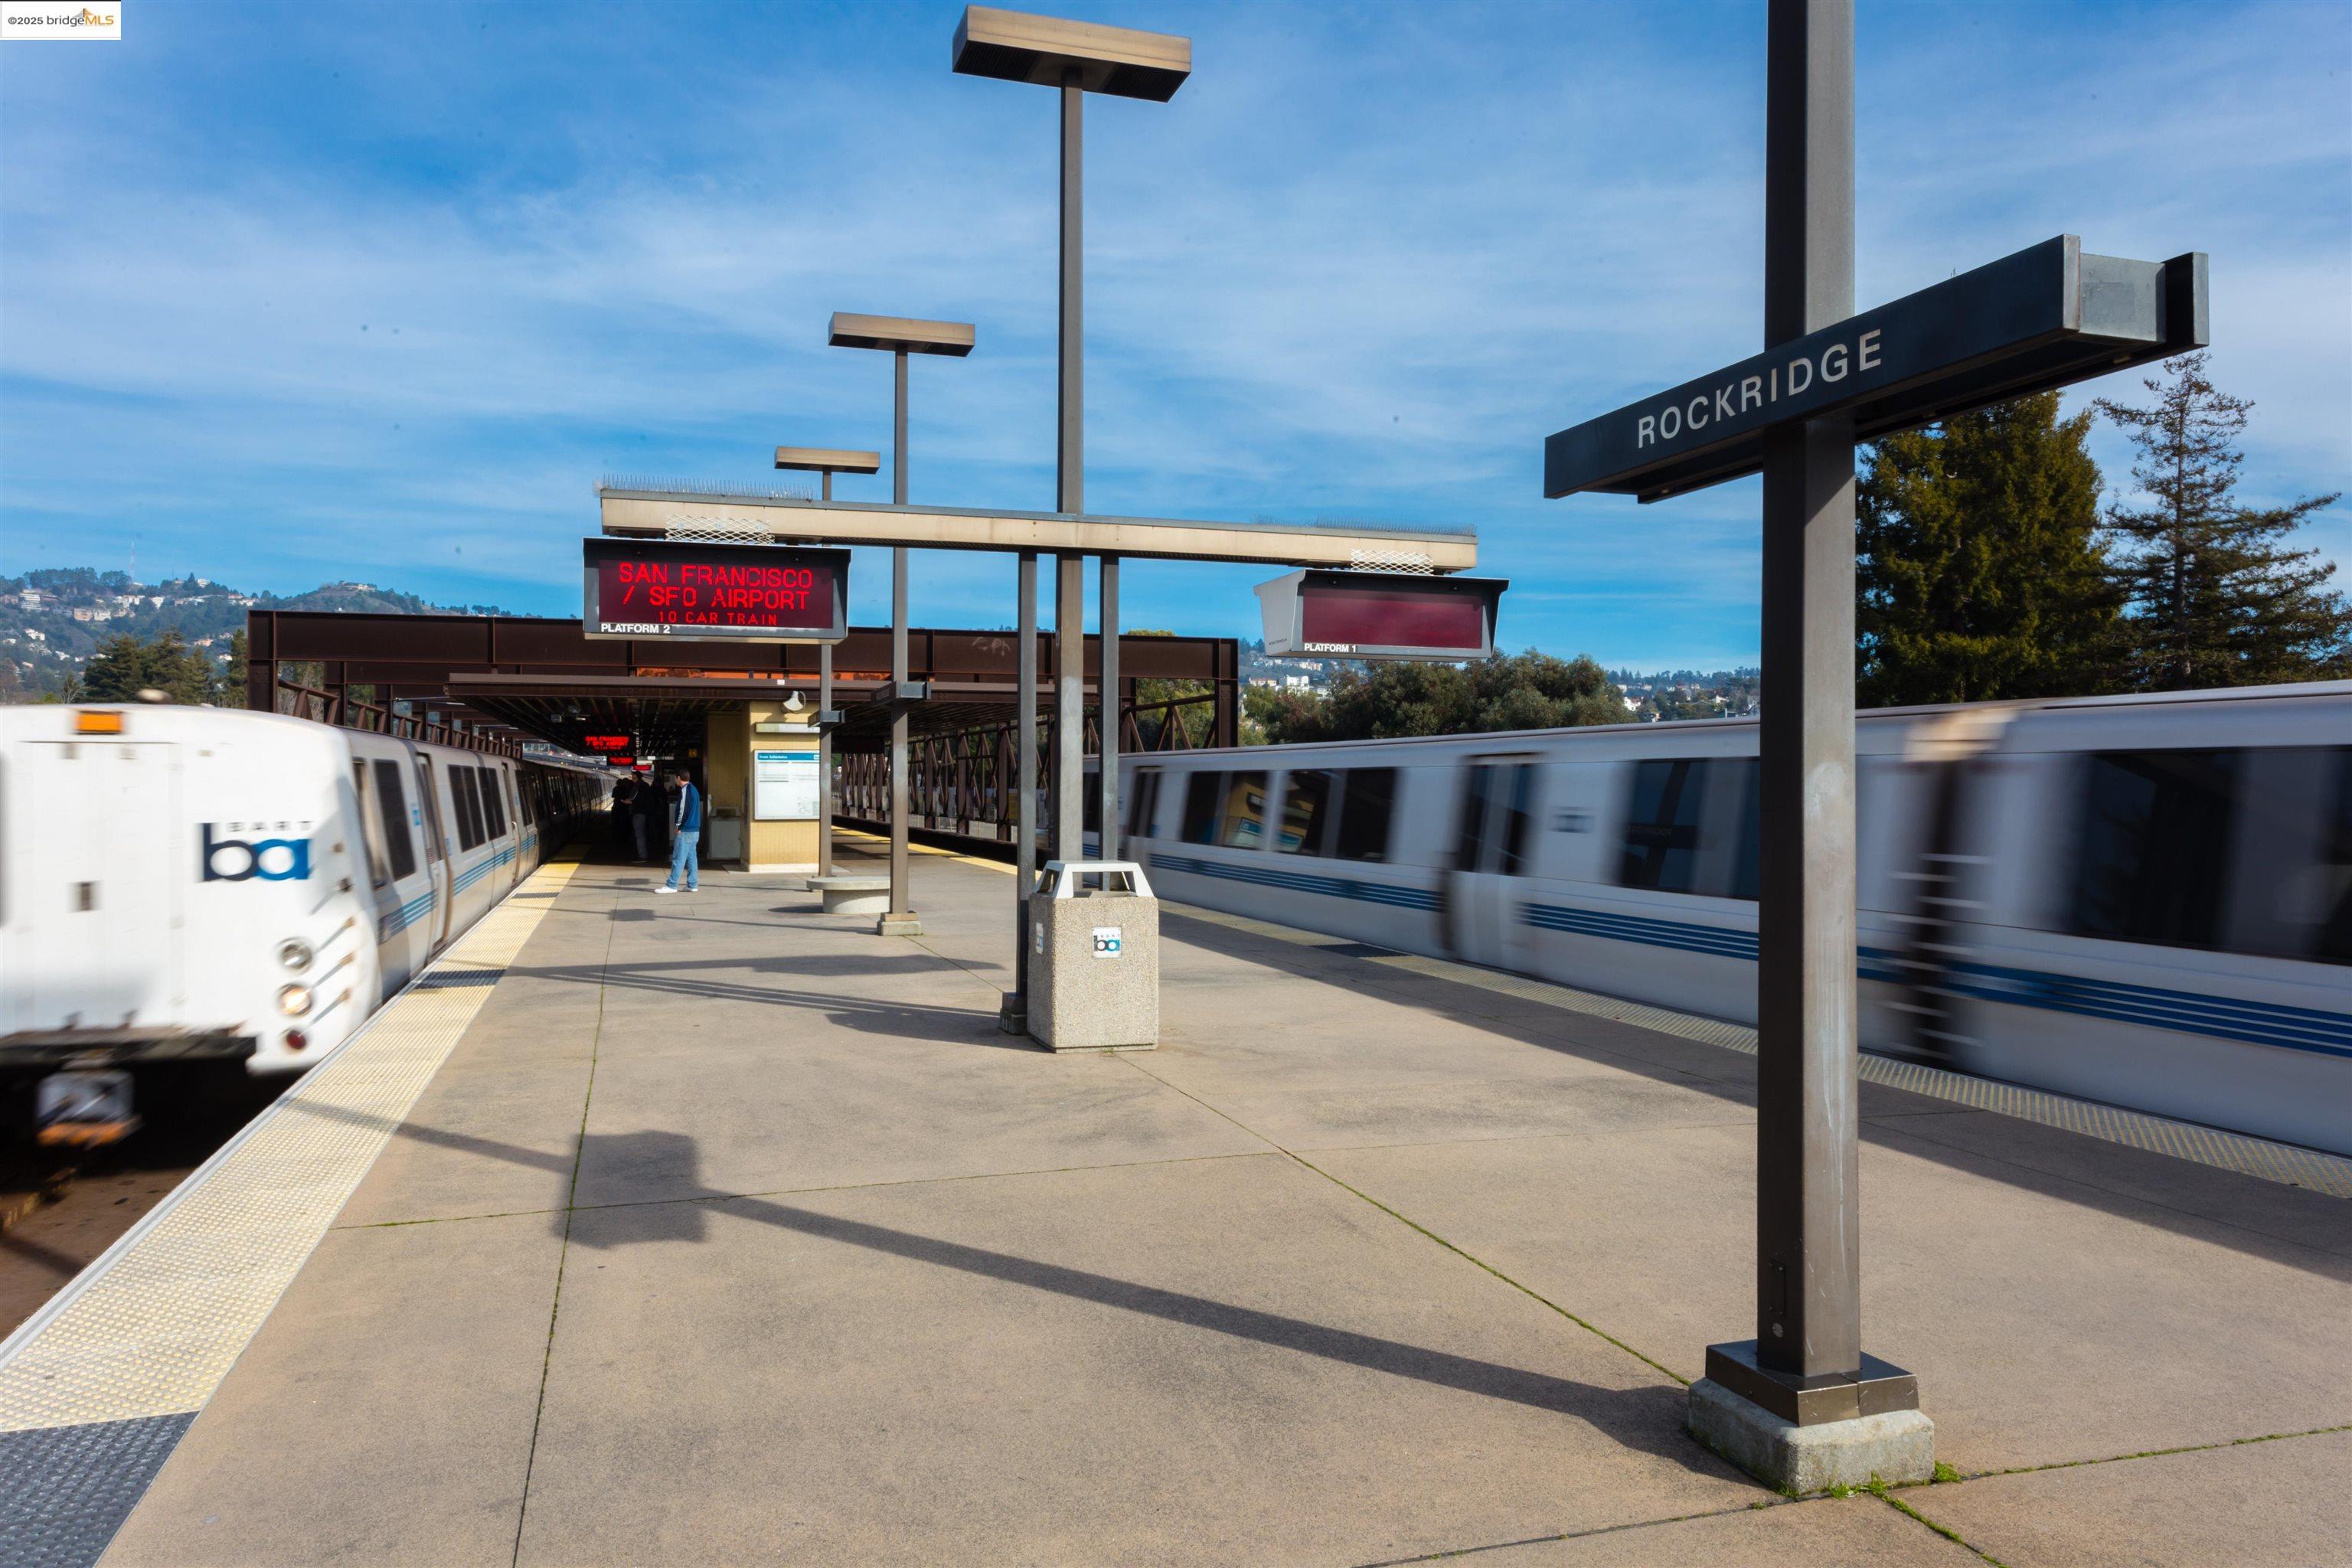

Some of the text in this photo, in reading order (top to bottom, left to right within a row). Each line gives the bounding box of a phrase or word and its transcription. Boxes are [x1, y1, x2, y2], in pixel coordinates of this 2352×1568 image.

[1637, 328, 1882, 449] ROCKRIDGE
[619, 562, 813, 589] SAN FRANCISCO
[649, 586, 697, 607] SFO
[711, 590, 810, 610] AIRPORT
[658, 611, 777, 626] 10 CAR TRAIN
[600, 623, 671, 634] PLATFORM 2
[1304, 643, 1357, 653] PLATFORM 1
